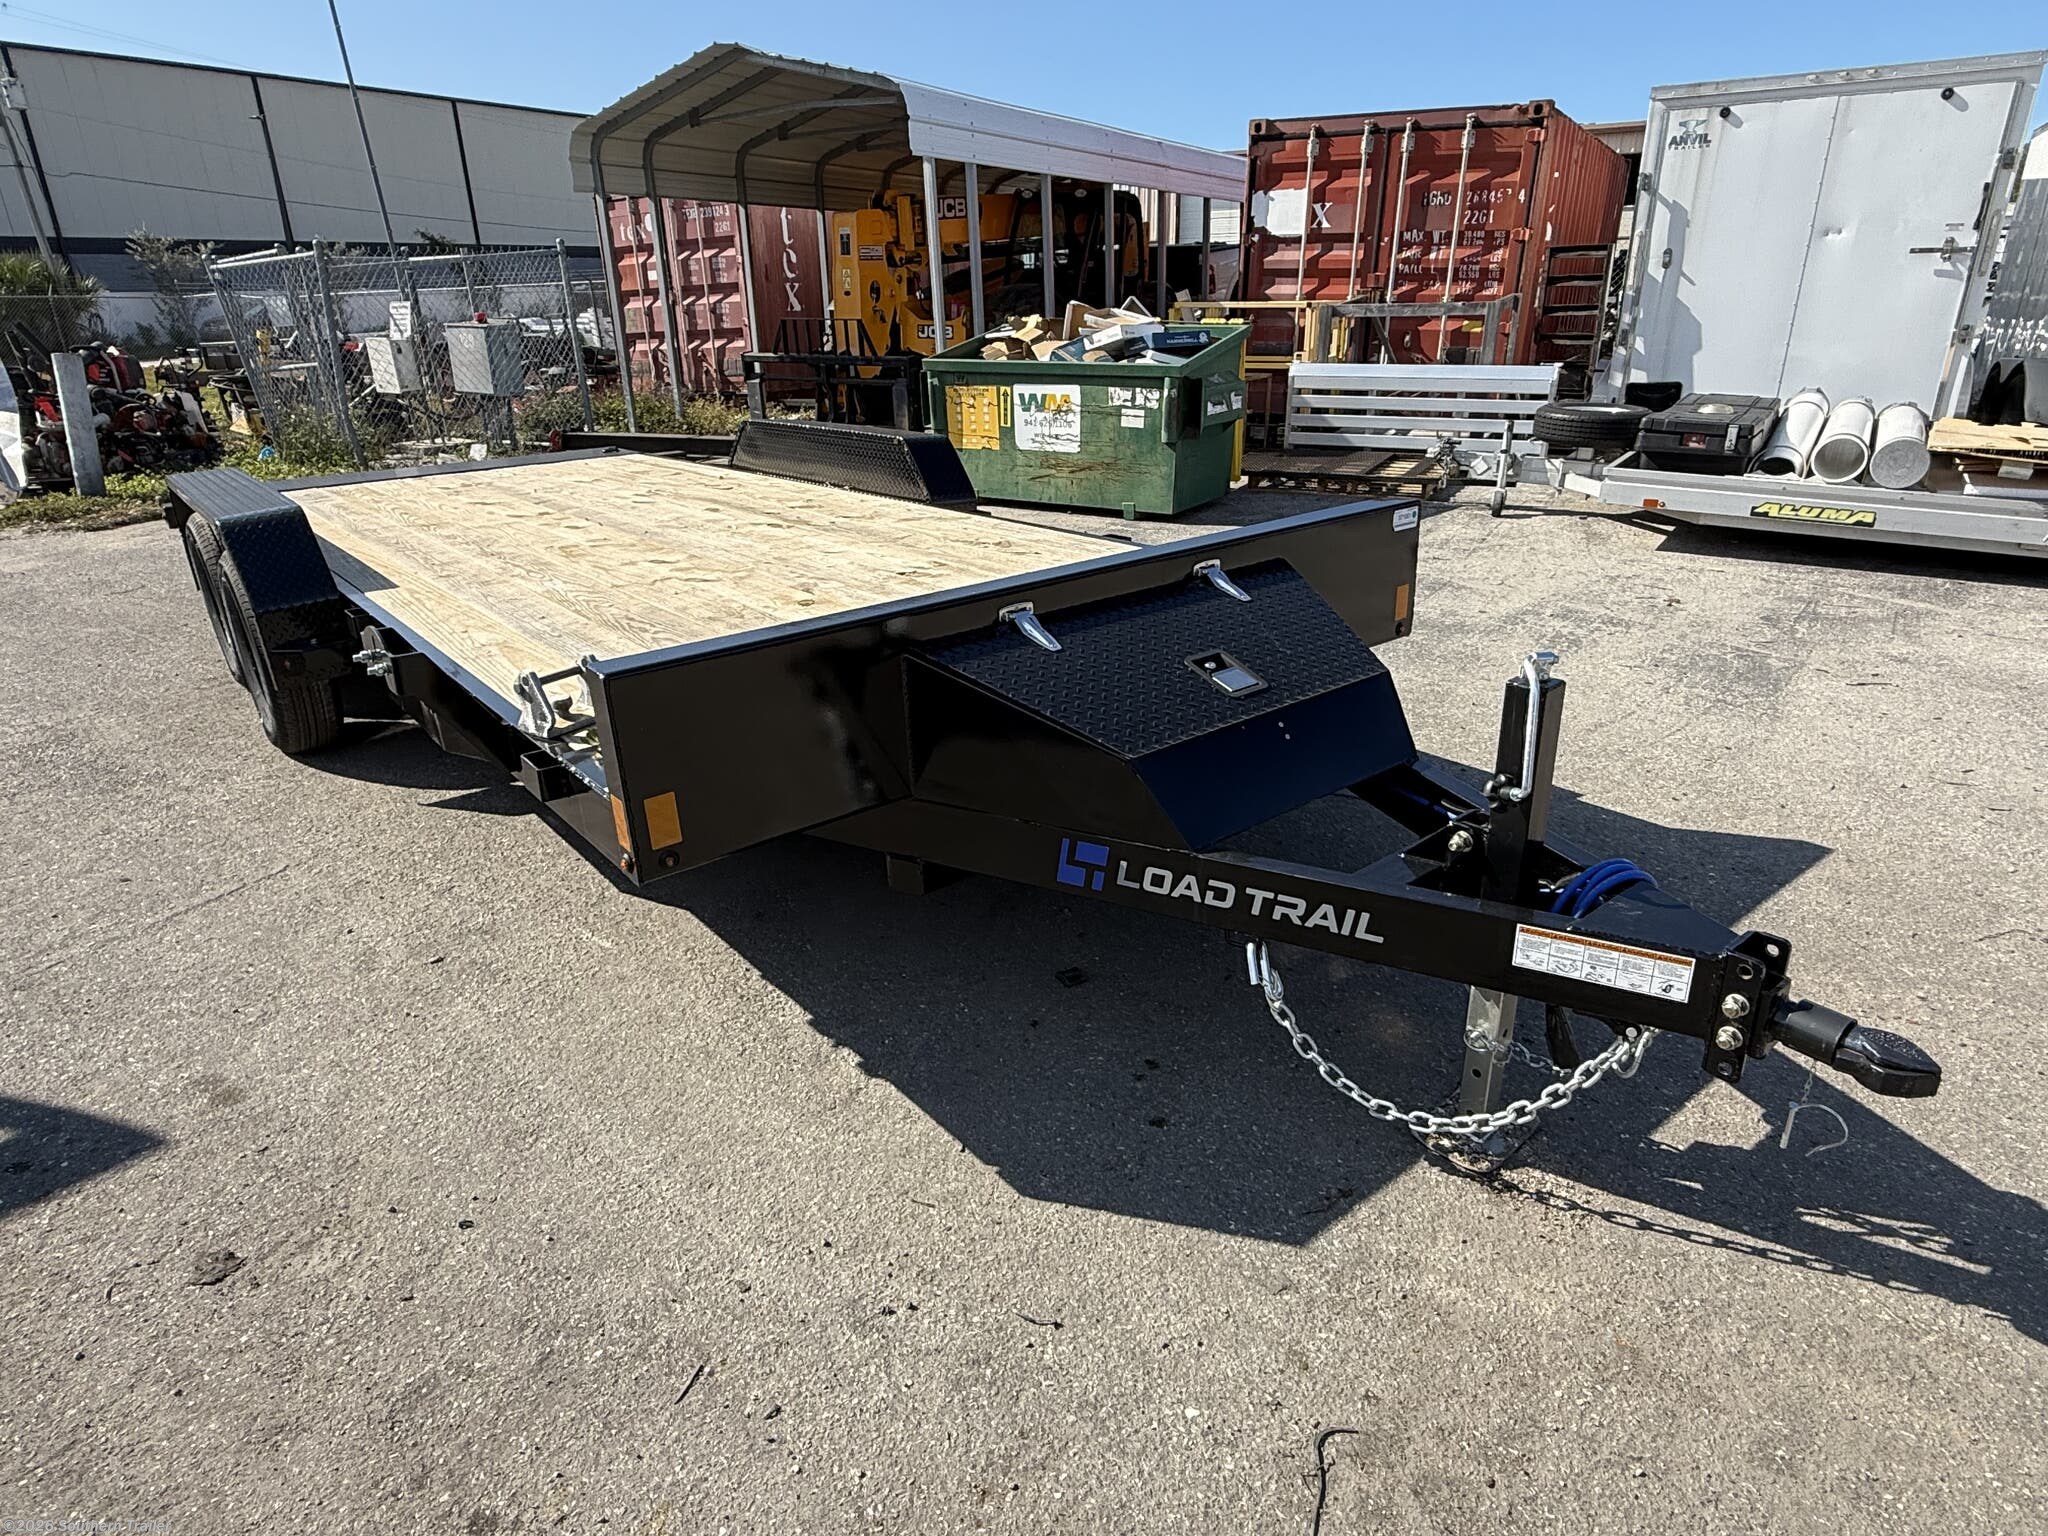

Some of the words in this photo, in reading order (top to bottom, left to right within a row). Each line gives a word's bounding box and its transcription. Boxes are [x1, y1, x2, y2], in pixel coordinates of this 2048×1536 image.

[1668, 133, 1712, 146] ANVIL
[937, 198, 966, 218] JCB
[1310, 202, 1333, 228] X
[1018, 393, 1071, 413] WM
[1753, 502, 1876, 524] ALUMA
[1117, 860, 1236, 909] LOAD
[1245, 887, 1385, 944] TRAIL
